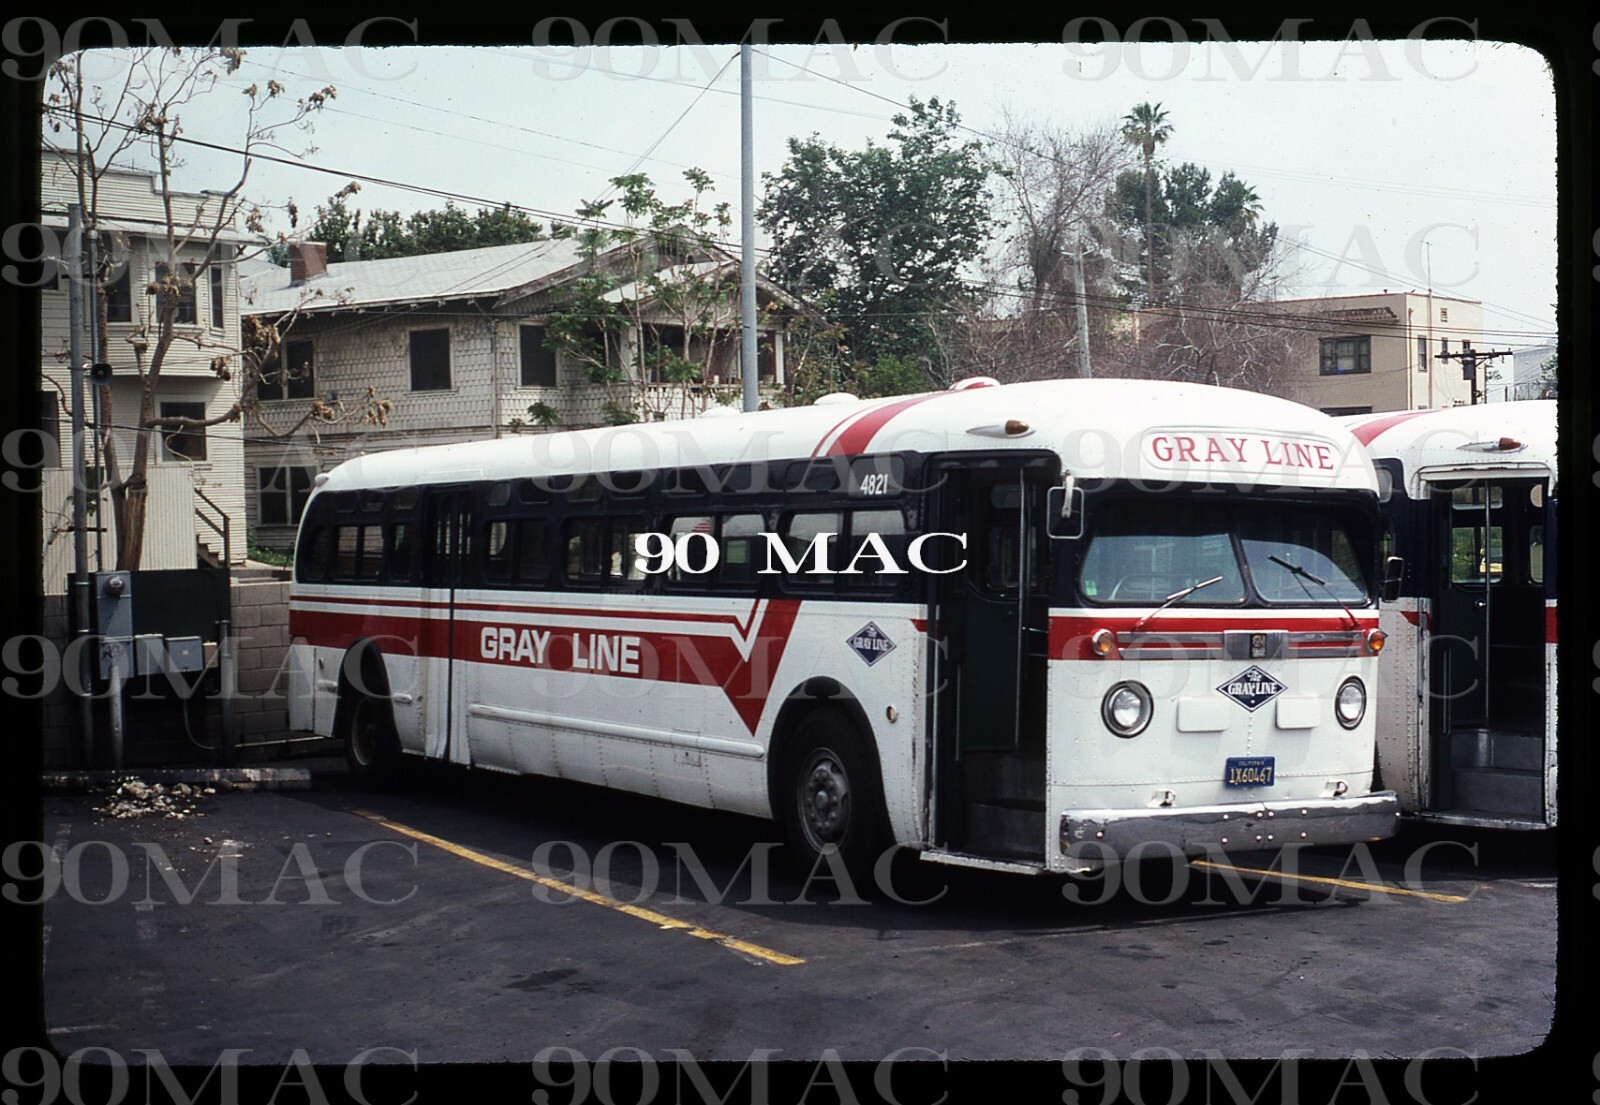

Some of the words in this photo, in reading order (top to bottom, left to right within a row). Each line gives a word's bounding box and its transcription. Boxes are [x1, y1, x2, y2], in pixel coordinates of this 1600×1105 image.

[1151, 436, 1248, 462] GRAY
[1260, 440, 1335, 470] LINE
[860, 474, 888, 495] 4821
[480, 626, 551, 664] GRAY
[572, 633, 640, 674] LINE
[1227, 682, 1255, 695] GRAY
[1255, 682, 1277, 695] LINE
[1229, 767, 1272, 784] 1X60467
